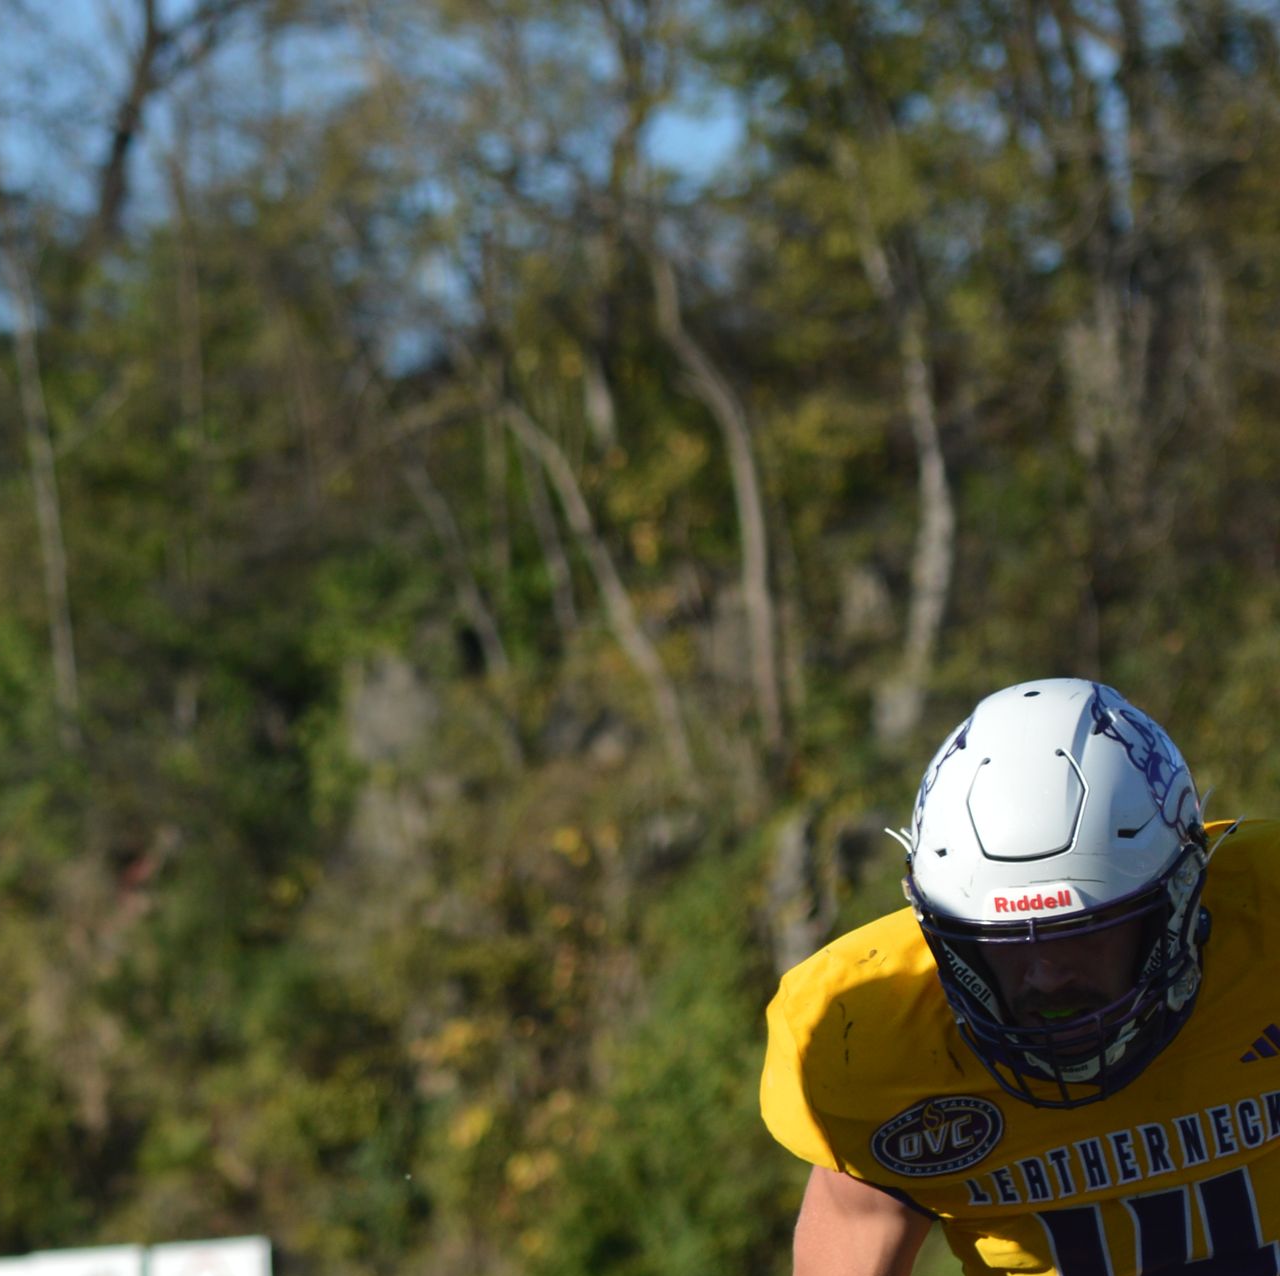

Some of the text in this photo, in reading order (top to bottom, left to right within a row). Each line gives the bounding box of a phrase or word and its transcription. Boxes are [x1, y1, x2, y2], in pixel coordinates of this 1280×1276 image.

[994, 890, 1072, 912] Riddell
[940, 1100, 993, 1113] VALLEY
[898, 1113, 976, 1160] OVC
